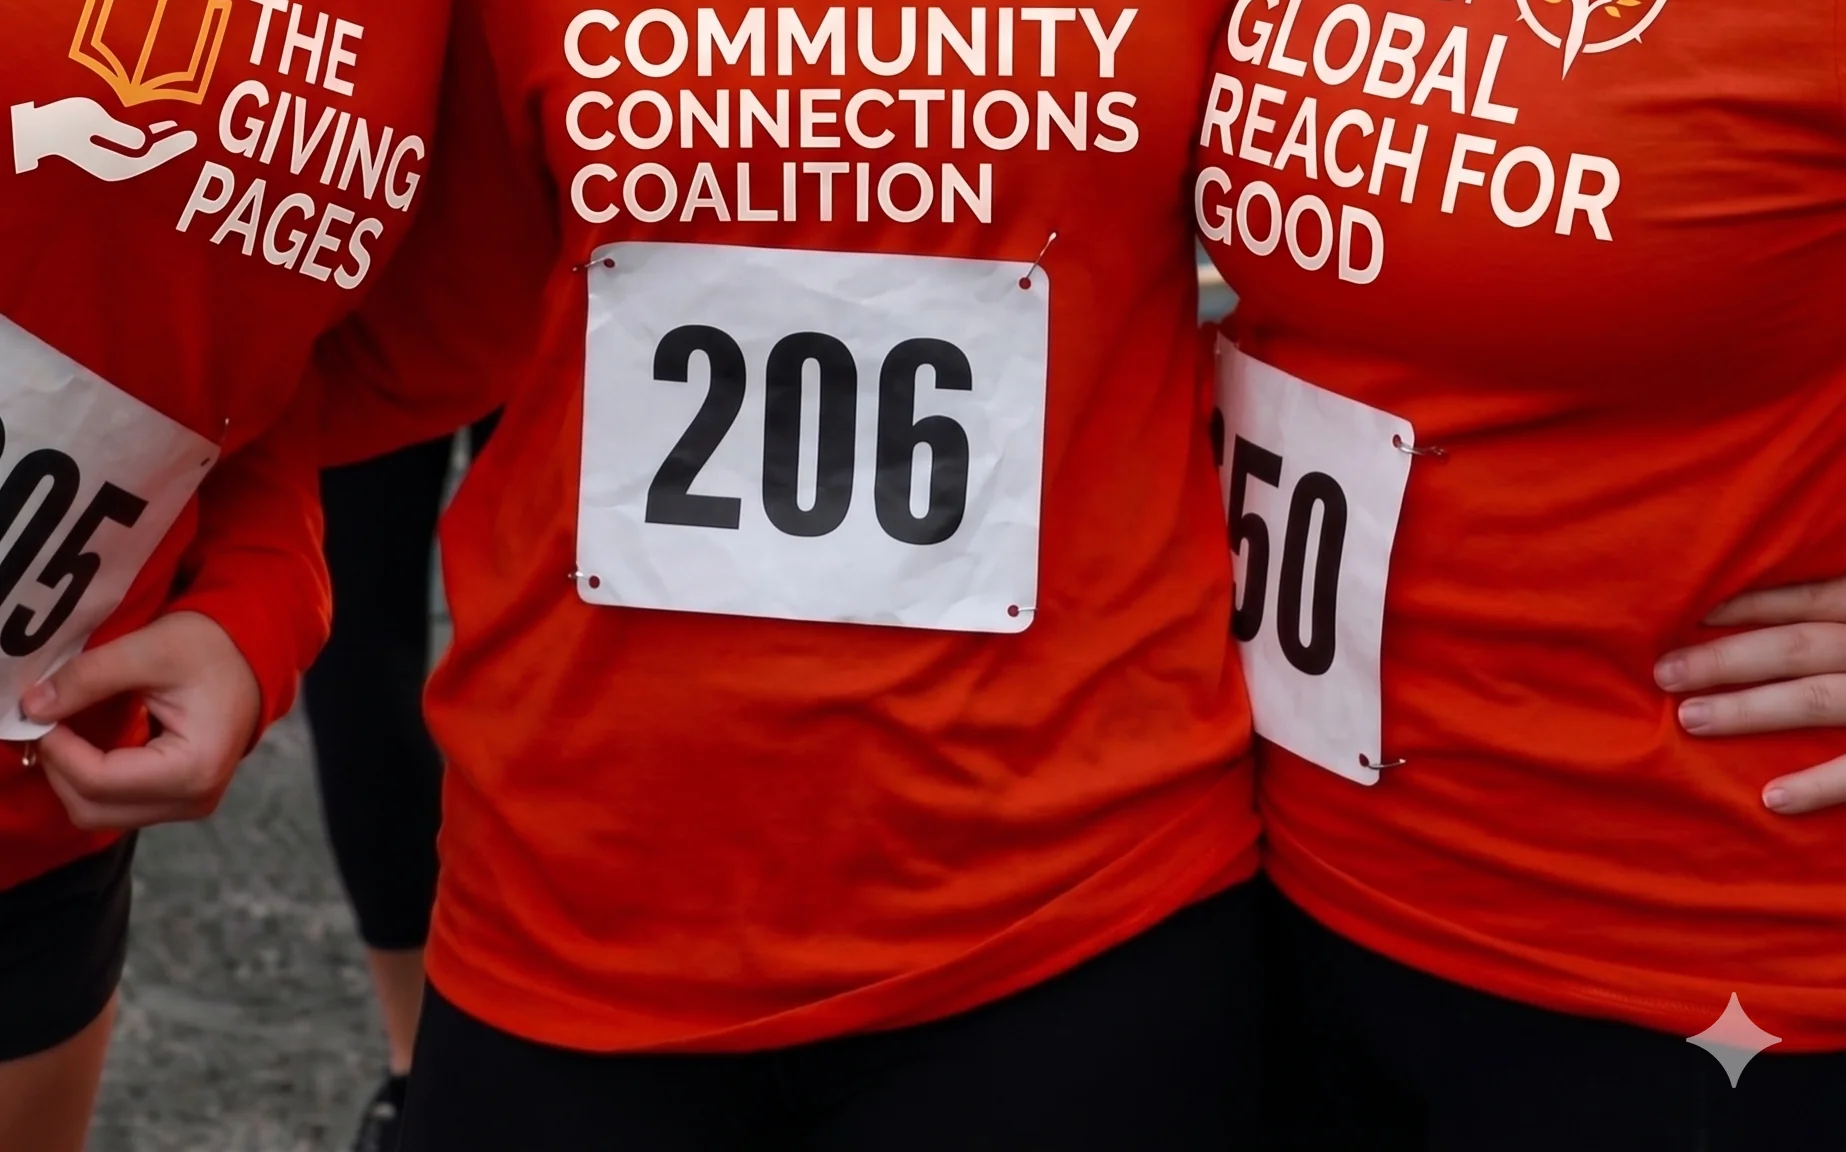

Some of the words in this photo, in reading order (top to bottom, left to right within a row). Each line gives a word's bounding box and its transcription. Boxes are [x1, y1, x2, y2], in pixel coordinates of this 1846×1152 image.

[563, 6, 1139, 79] COMMUNITY
[218, 79, 426, 212] GIVING
[564, 88, 1140, 153] CONNECTIONS
[1199, 72, 1429, 205] REACH
[1440, 132, 1621, 242] FOR
[175, 160, 384, 290] PAGES
[570, 161, 993, 224] COALITION
[1194, 166, 1385, 286] GOOD
[644, 324, 973, 546] 206
[0, 416, 149, 657] 05
[1209, 405, 1348, 676] 50
